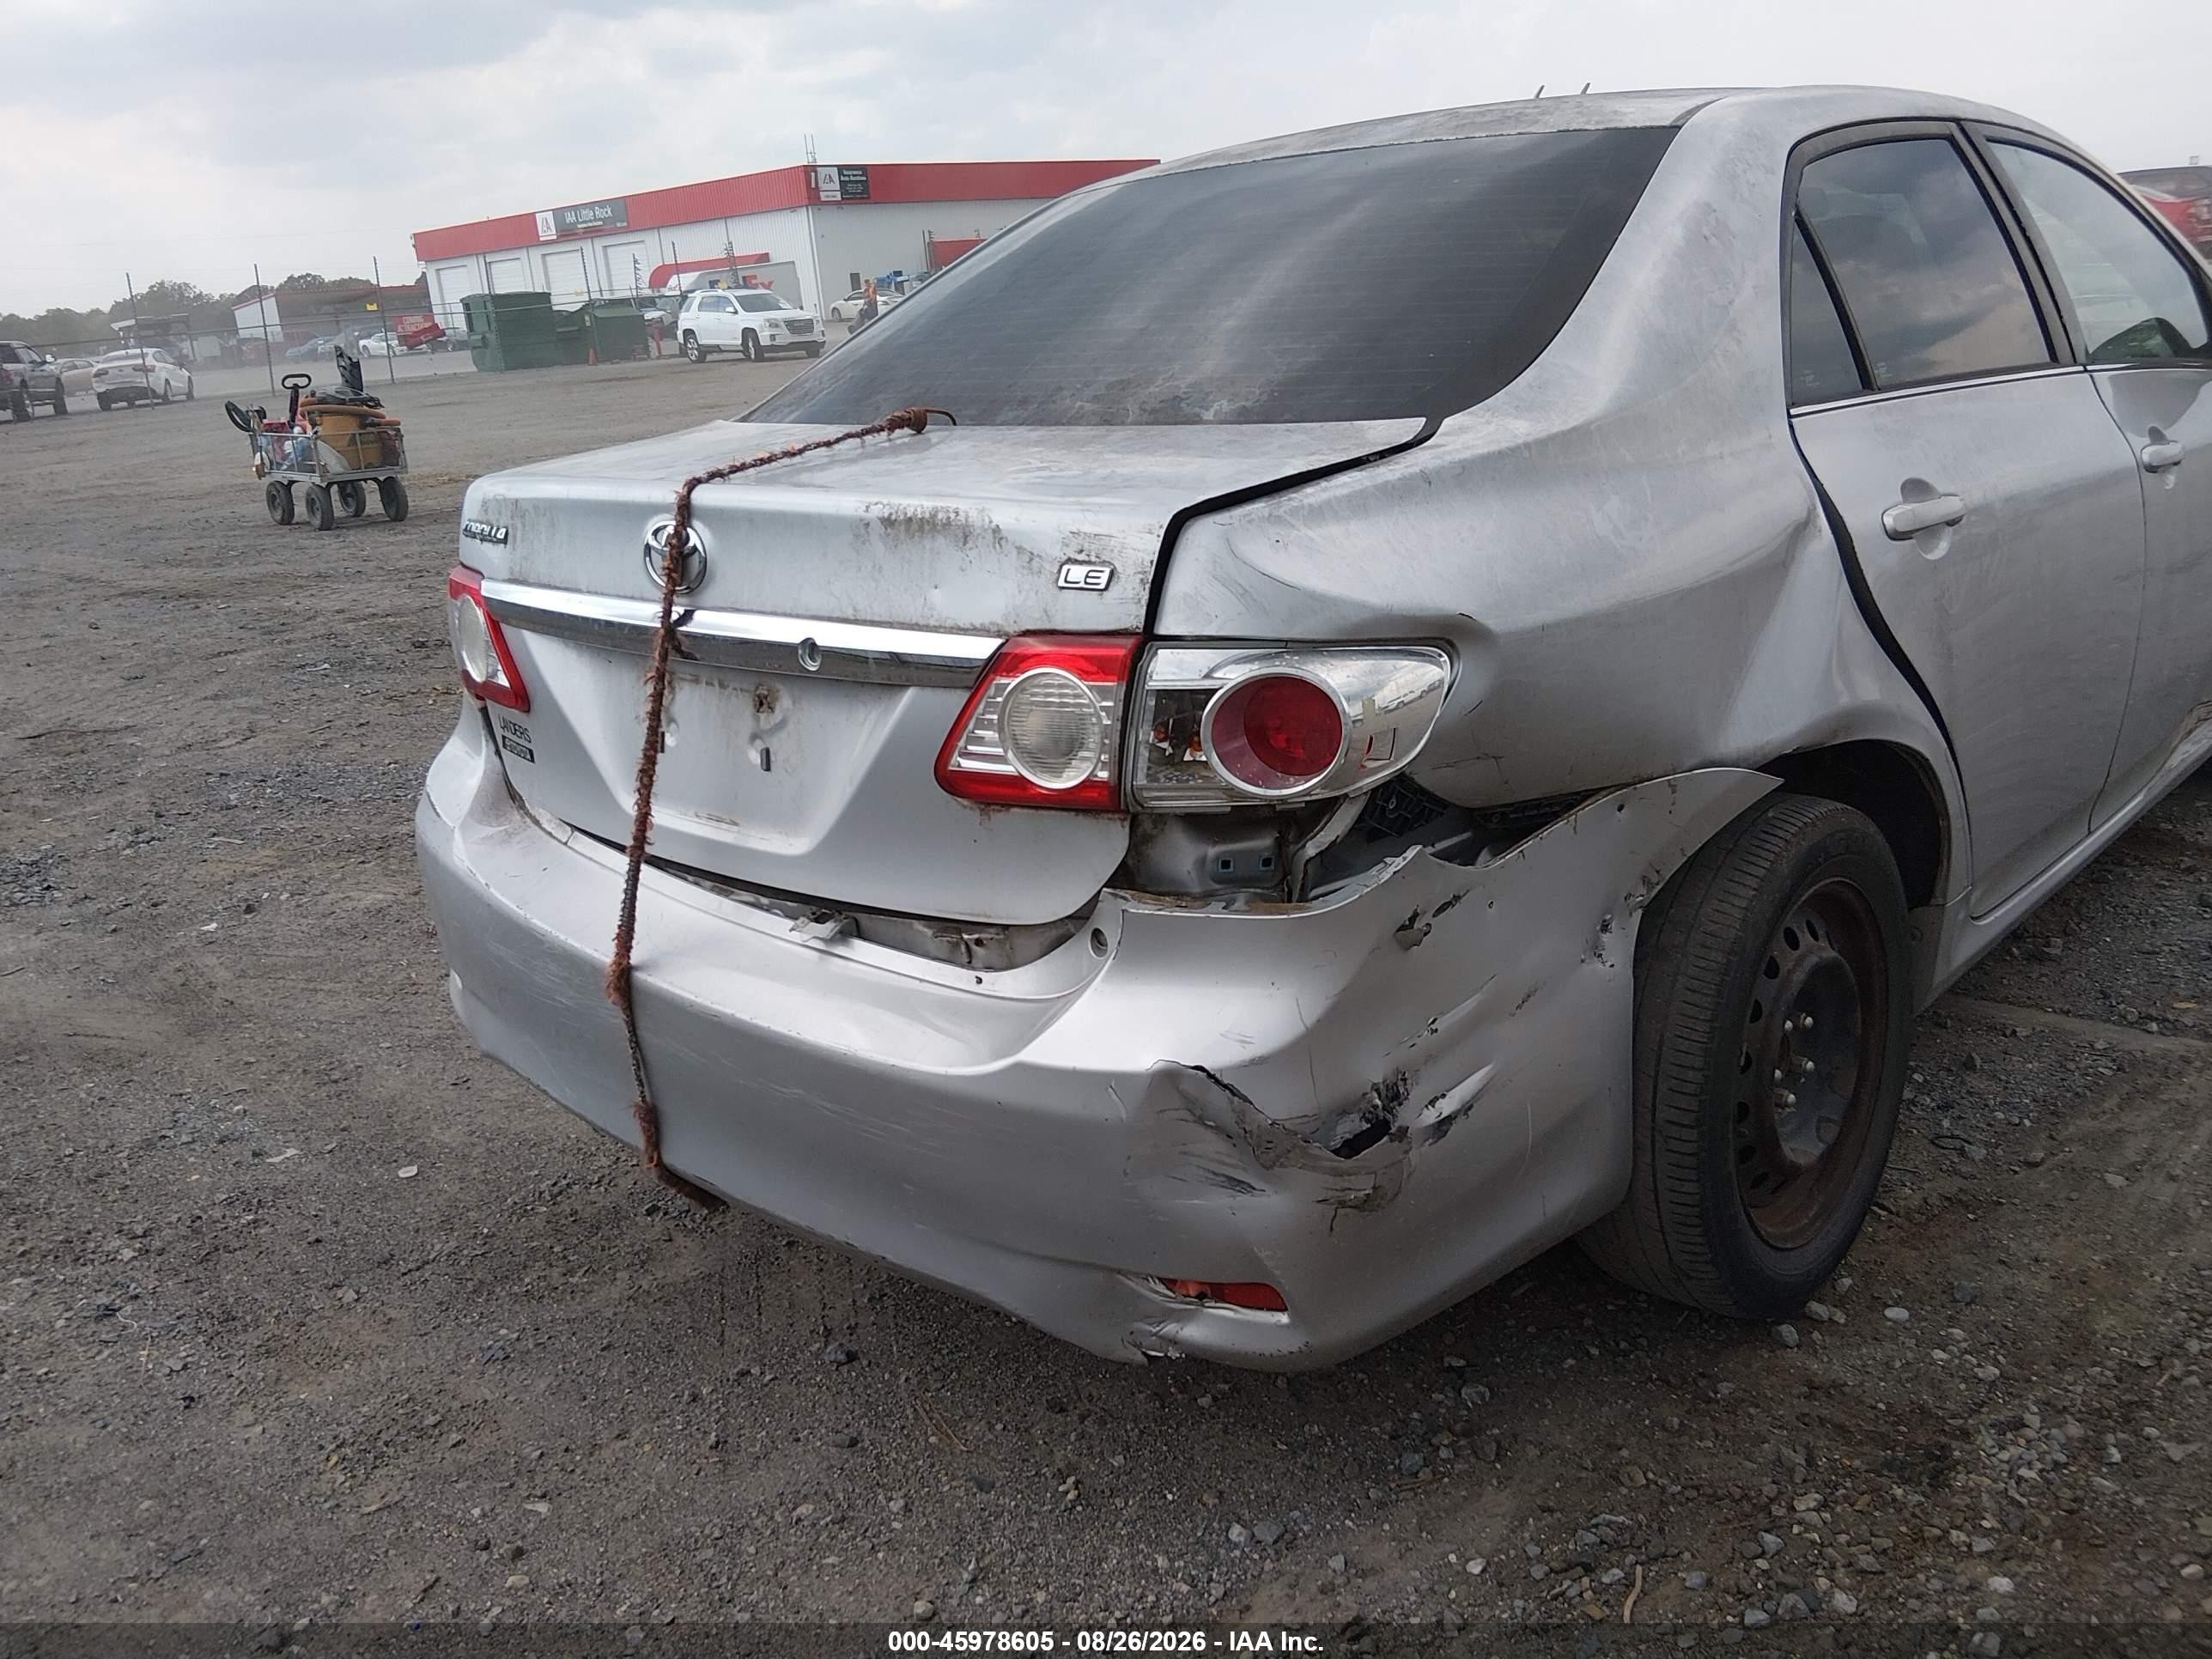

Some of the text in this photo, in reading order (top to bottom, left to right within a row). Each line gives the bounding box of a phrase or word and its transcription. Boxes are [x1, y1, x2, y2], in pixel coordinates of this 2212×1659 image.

[564, 205, 613, 223] IAA Little Rock
[708, 273, 775, 289] FdEx
[1064, 568, 1106, 586] LE
[498, 714, 532, 744] LANDERS
